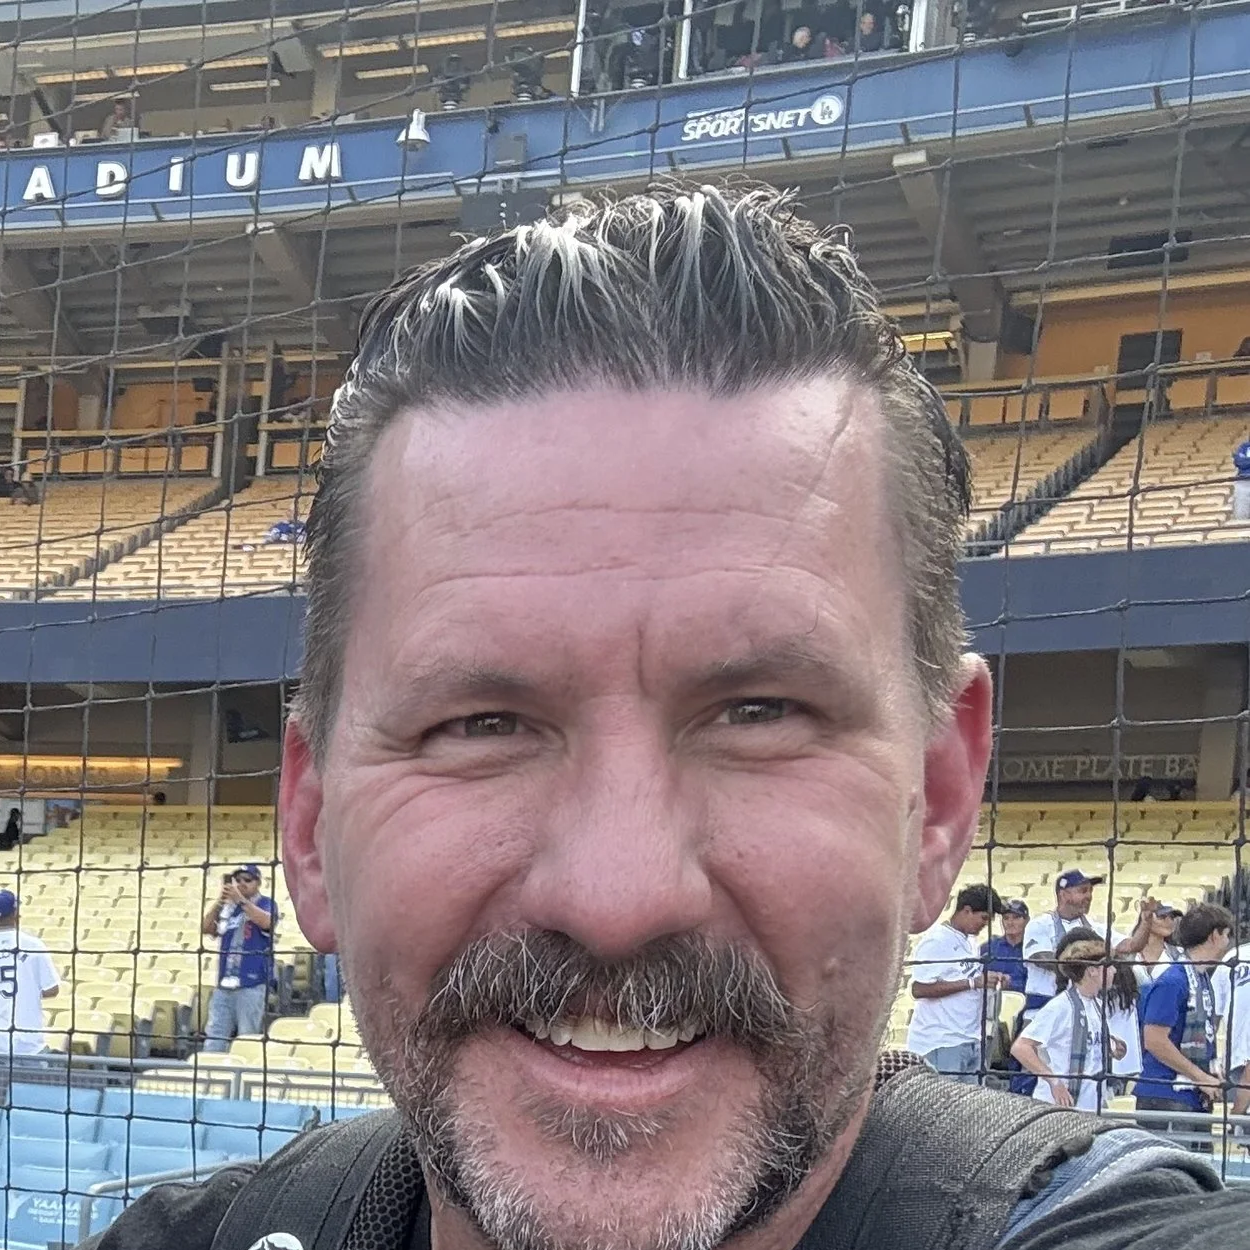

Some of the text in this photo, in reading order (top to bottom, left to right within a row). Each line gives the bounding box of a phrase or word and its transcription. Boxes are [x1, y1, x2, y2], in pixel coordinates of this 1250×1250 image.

[1002, 754, 1197, 779] OME PLATE BA
